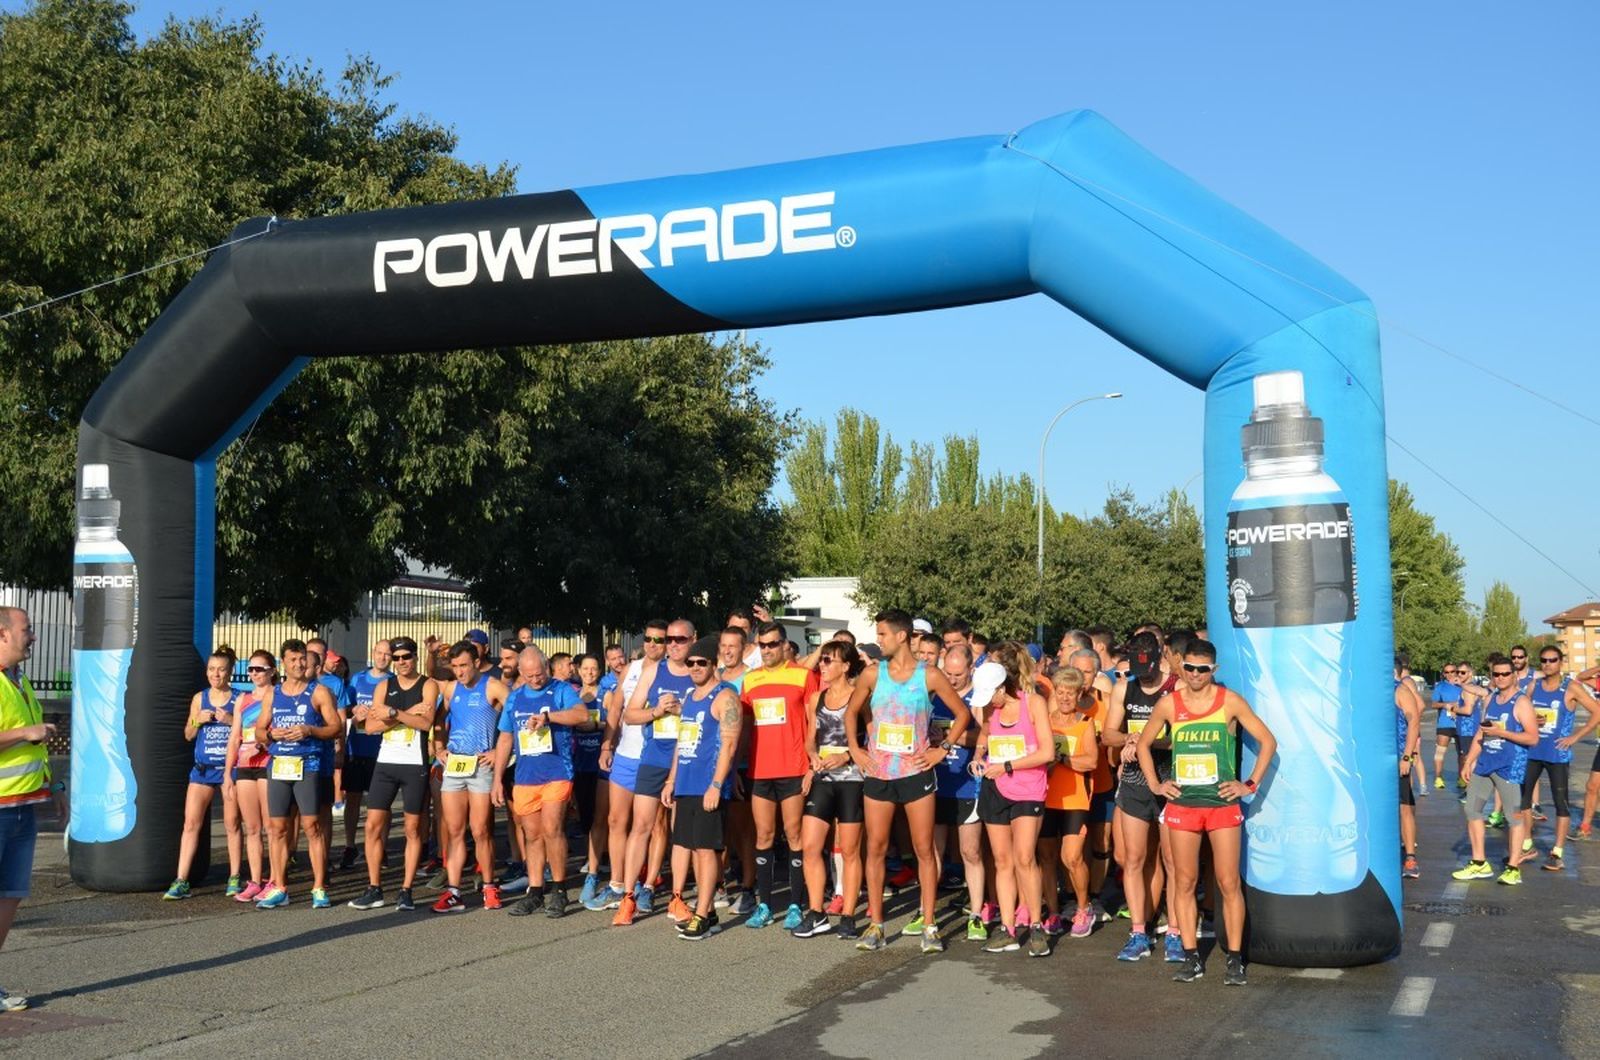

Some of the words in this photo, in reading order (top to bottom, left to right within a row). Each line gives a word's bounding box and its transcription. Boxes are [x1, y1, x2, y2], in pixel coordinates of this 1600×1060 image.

[373, 191, 836, 293] POWERADE
[1228, 520, 1349, 546] POWERADE
[73, 575, 133, 589] WERADE
